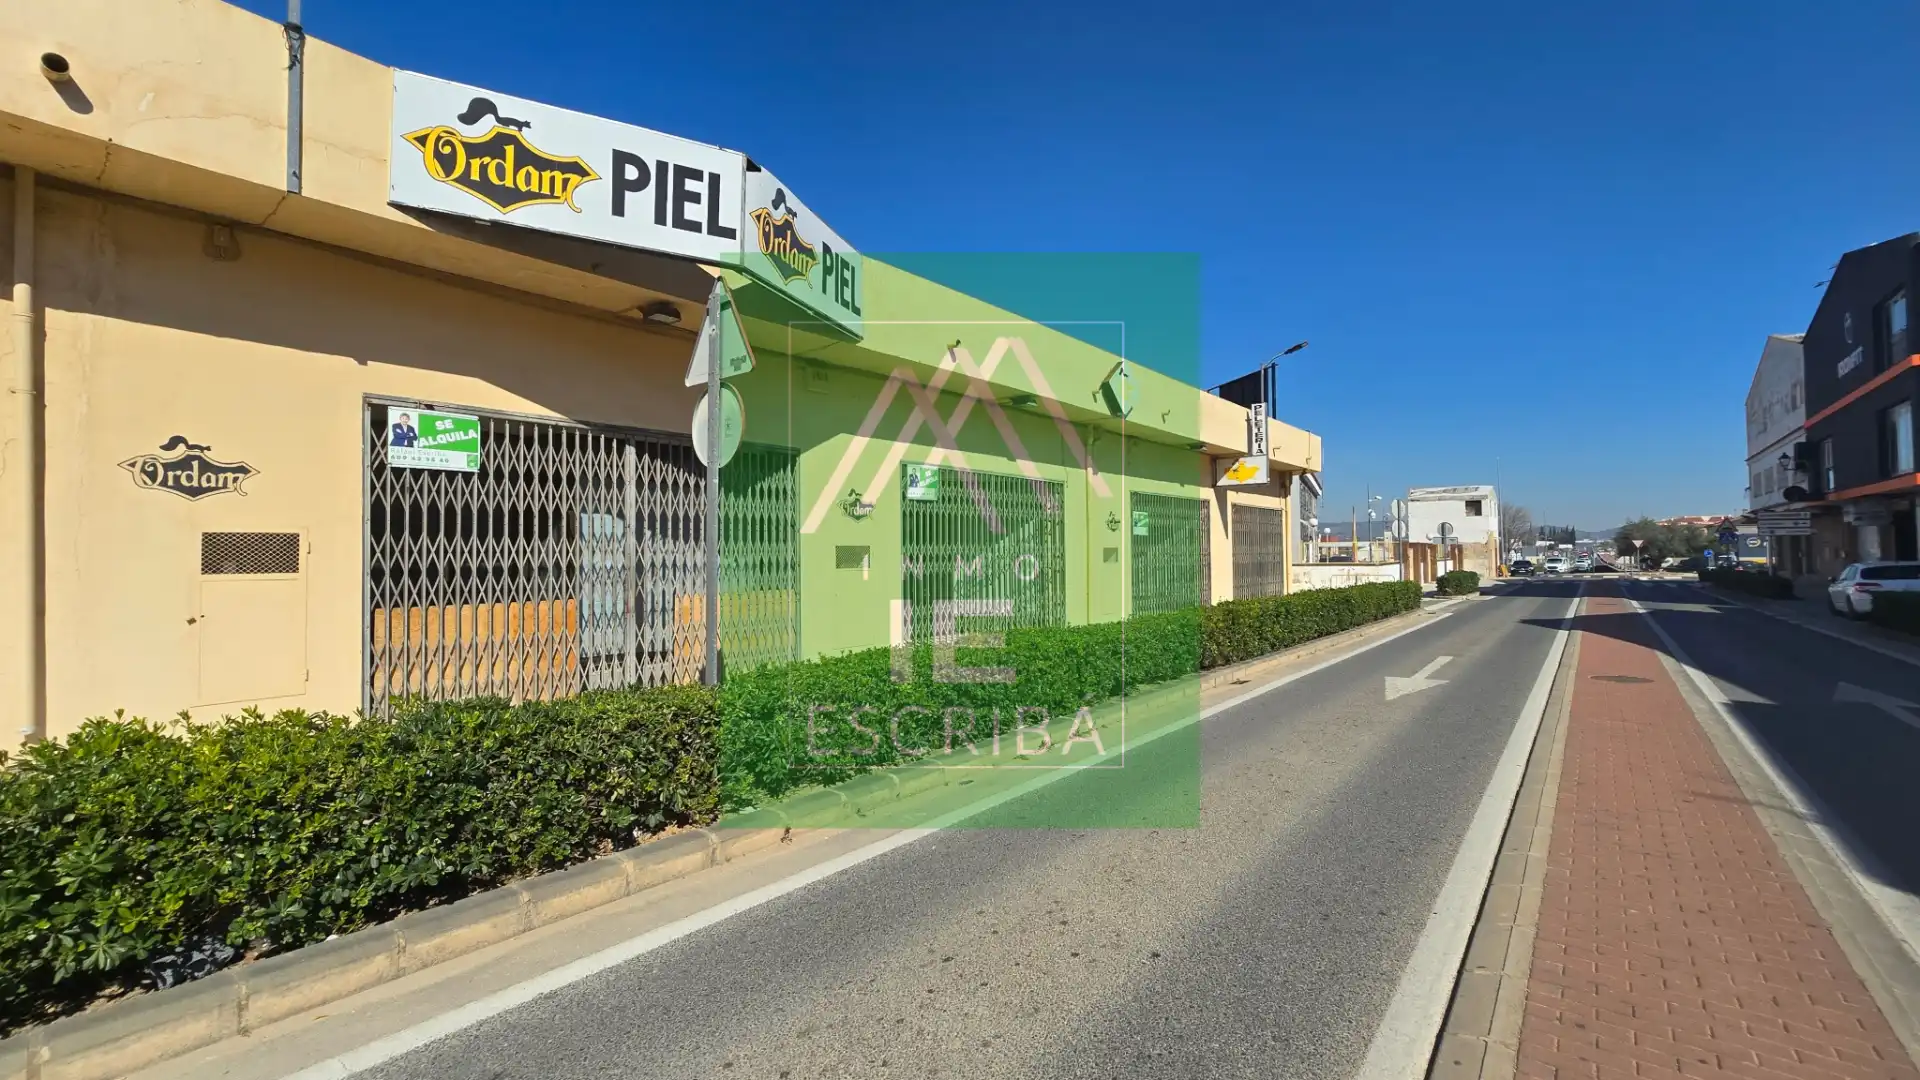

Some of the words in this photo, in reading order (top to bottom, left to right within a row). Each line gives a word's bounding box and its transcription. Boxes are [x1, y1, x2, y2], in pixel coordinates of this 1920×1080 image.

[423, 126, 582, 213] Ordam
[611, 148, 737, 240] PIEL
[758, 207, 814, 289] Ordam
[822, 240, 861, 317] PIEL
[419, 429, 478, 448] ALQUILA
[435, 419, 454, 430] SE
[133, 454, 248, 496] Ordam
